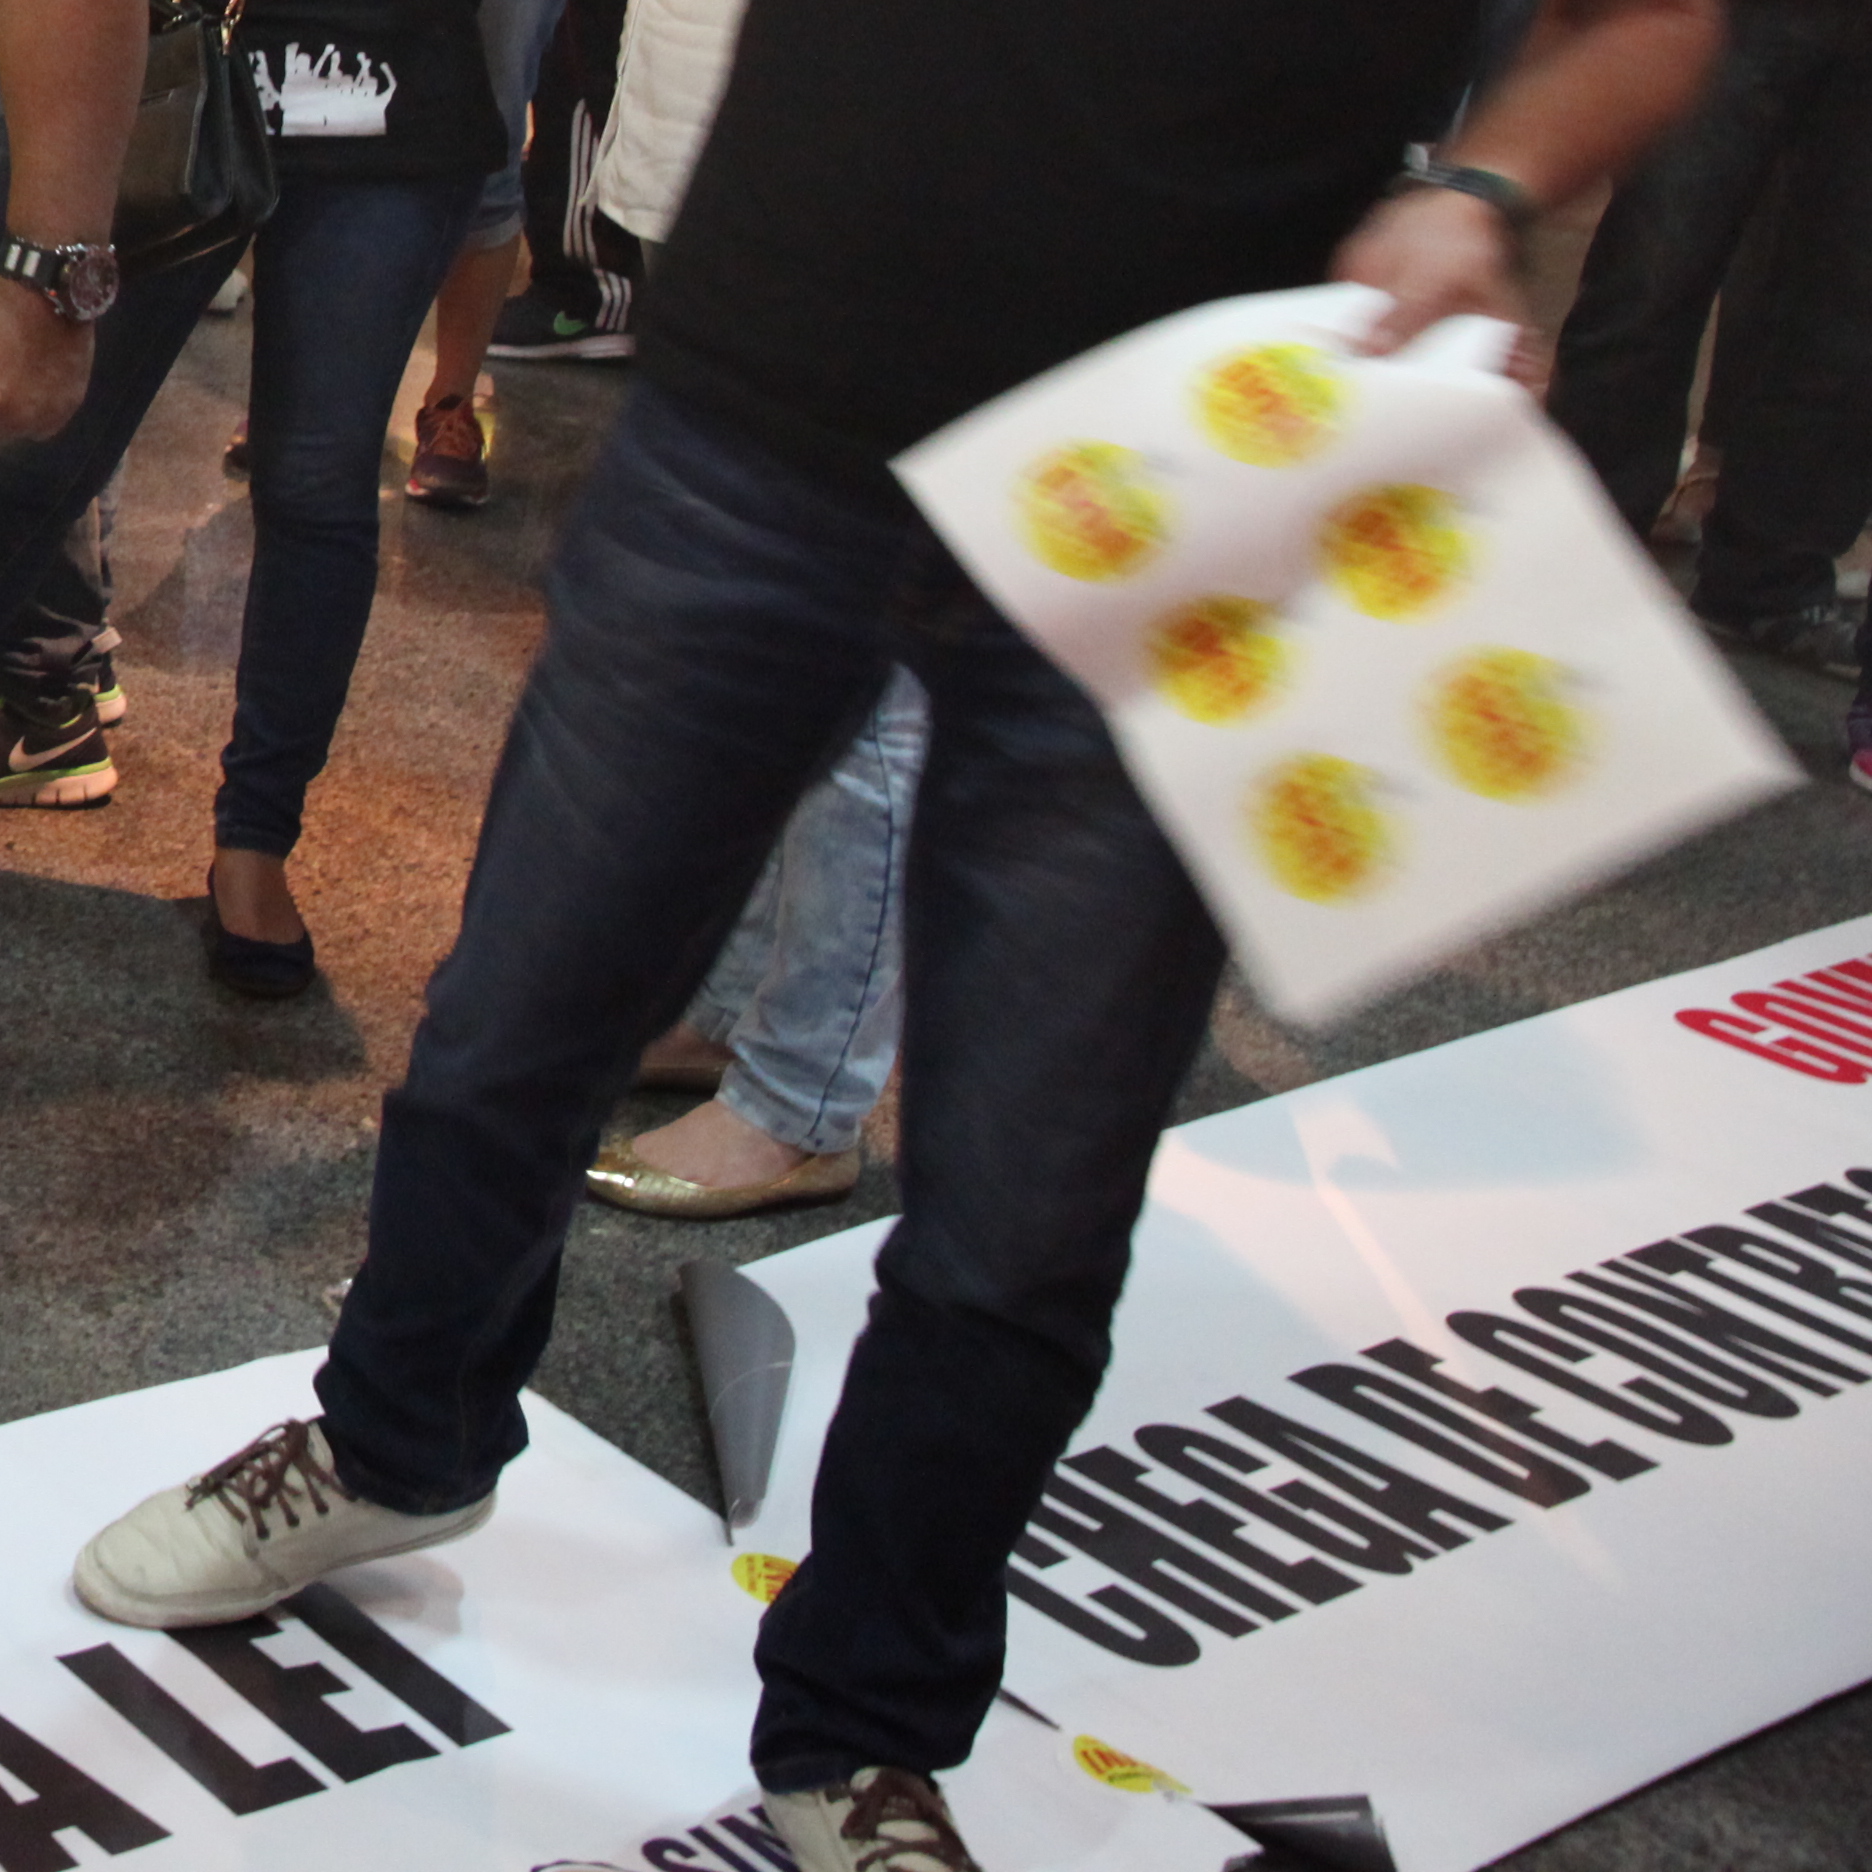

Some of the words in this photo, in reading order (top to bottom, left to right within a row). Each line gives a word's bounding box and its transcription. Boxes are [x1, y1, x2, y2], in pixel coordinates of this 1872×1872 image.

[1005, 1394, 1518, 1668] CHEGA
[1286, 1336, 1662, 1510] DE
[54, 1581, 515, 1818] LEI
